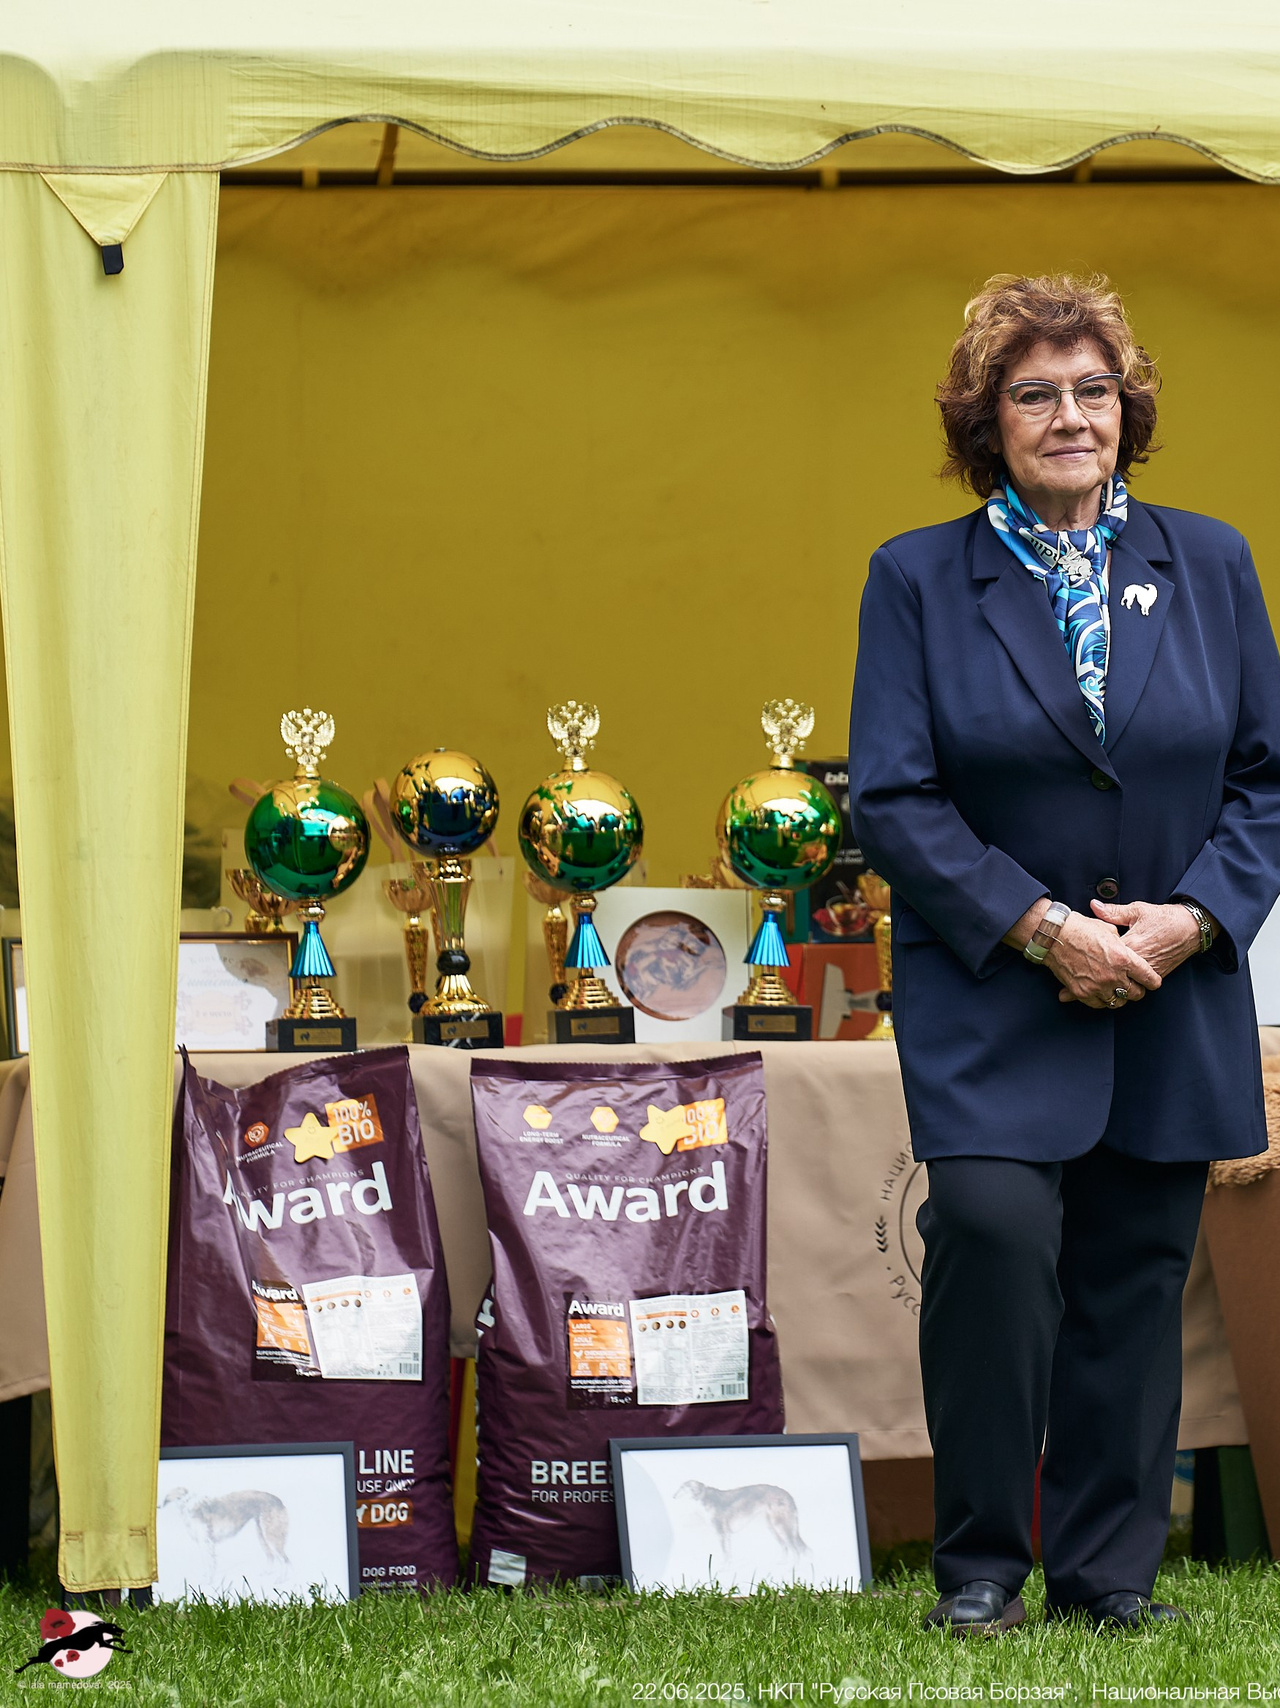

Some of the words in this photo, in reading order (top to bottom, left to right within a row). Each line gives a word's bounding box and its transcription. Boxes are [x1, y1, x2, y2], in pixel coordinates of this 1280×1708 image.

[333, 1100, 372, 1123] 100%
[338, 1118, 374, 1146] BIO
[582, 1134, 630, 1142] NUTRACEUTICAL
[246, 1150, 276, 1164] FORMULA
[274, 1180, 296, 1190] FOR
[299, 1168, 364, 1186] CHAMPIONS
[566, 1172, 610, 1182] QUALITY
[614, 1175, 635, 1183] FOR
[638, 1167, 704, 1184] CHAMPIONS
[223, 1161, 393, 1232] Award
[523, 1160, 729, 1223] Award
[252, 1280, 298, 1301] Award
[890, 1275, 921, 1316] РУСС
[568, 1300, 624, 1317] Award
[359, 1450, 414, 1474] LINE
[531, 1460, 613, 1485] BREE
[357, 1480, 382, 1493] USE
[532, 1490, 559, 1503] FOR
[370, 1502, 409, 1523] DOG
[362, 1566, 386, 1577] DOG
[388, 1565, 416, 1576] FOOD
